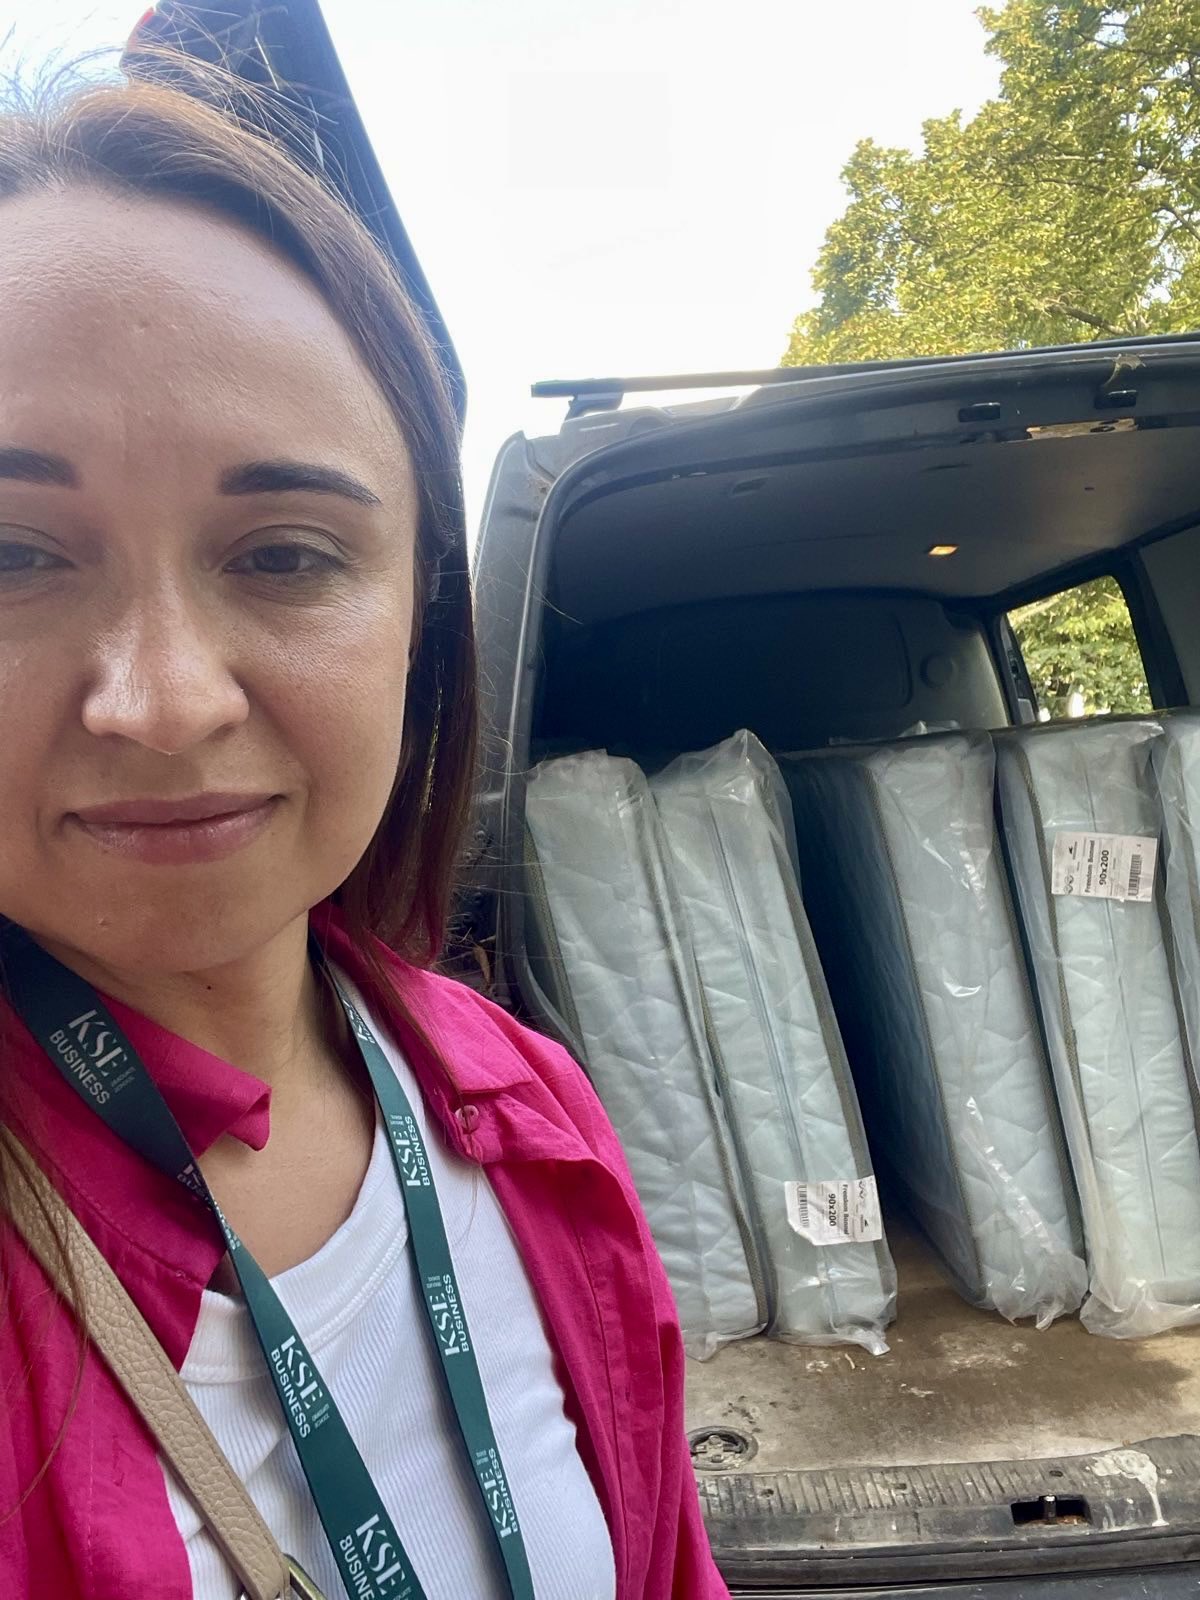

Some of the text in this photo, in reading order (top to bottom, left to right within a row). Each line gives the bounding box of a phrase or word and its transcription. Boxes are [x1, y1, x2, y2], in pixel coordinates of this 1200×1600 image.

[1099, 850, 1110, 885] 90x200
[49, 1029, 110, 1104] BUSINESS
[68, 1009, 128, 1077] KSE
[393, 1130, 421, 1187] KSE
[405, 1115, 430, 1186] BUSINESS
[828, 1193, 837, 1227] 90x200
[429, 1292, 460, 1356] KSE
[443, 1274, 470, 1352] BUSINESS
[271, 1348, 311, 1438] BUSINESS
[281, 1335, 323, 1409] KSE
[480, 1468, 511, 1538] KSE
[488, 1447, 518, 1532] BUSINESS
[355, 1513, 406, 1596] KSE
